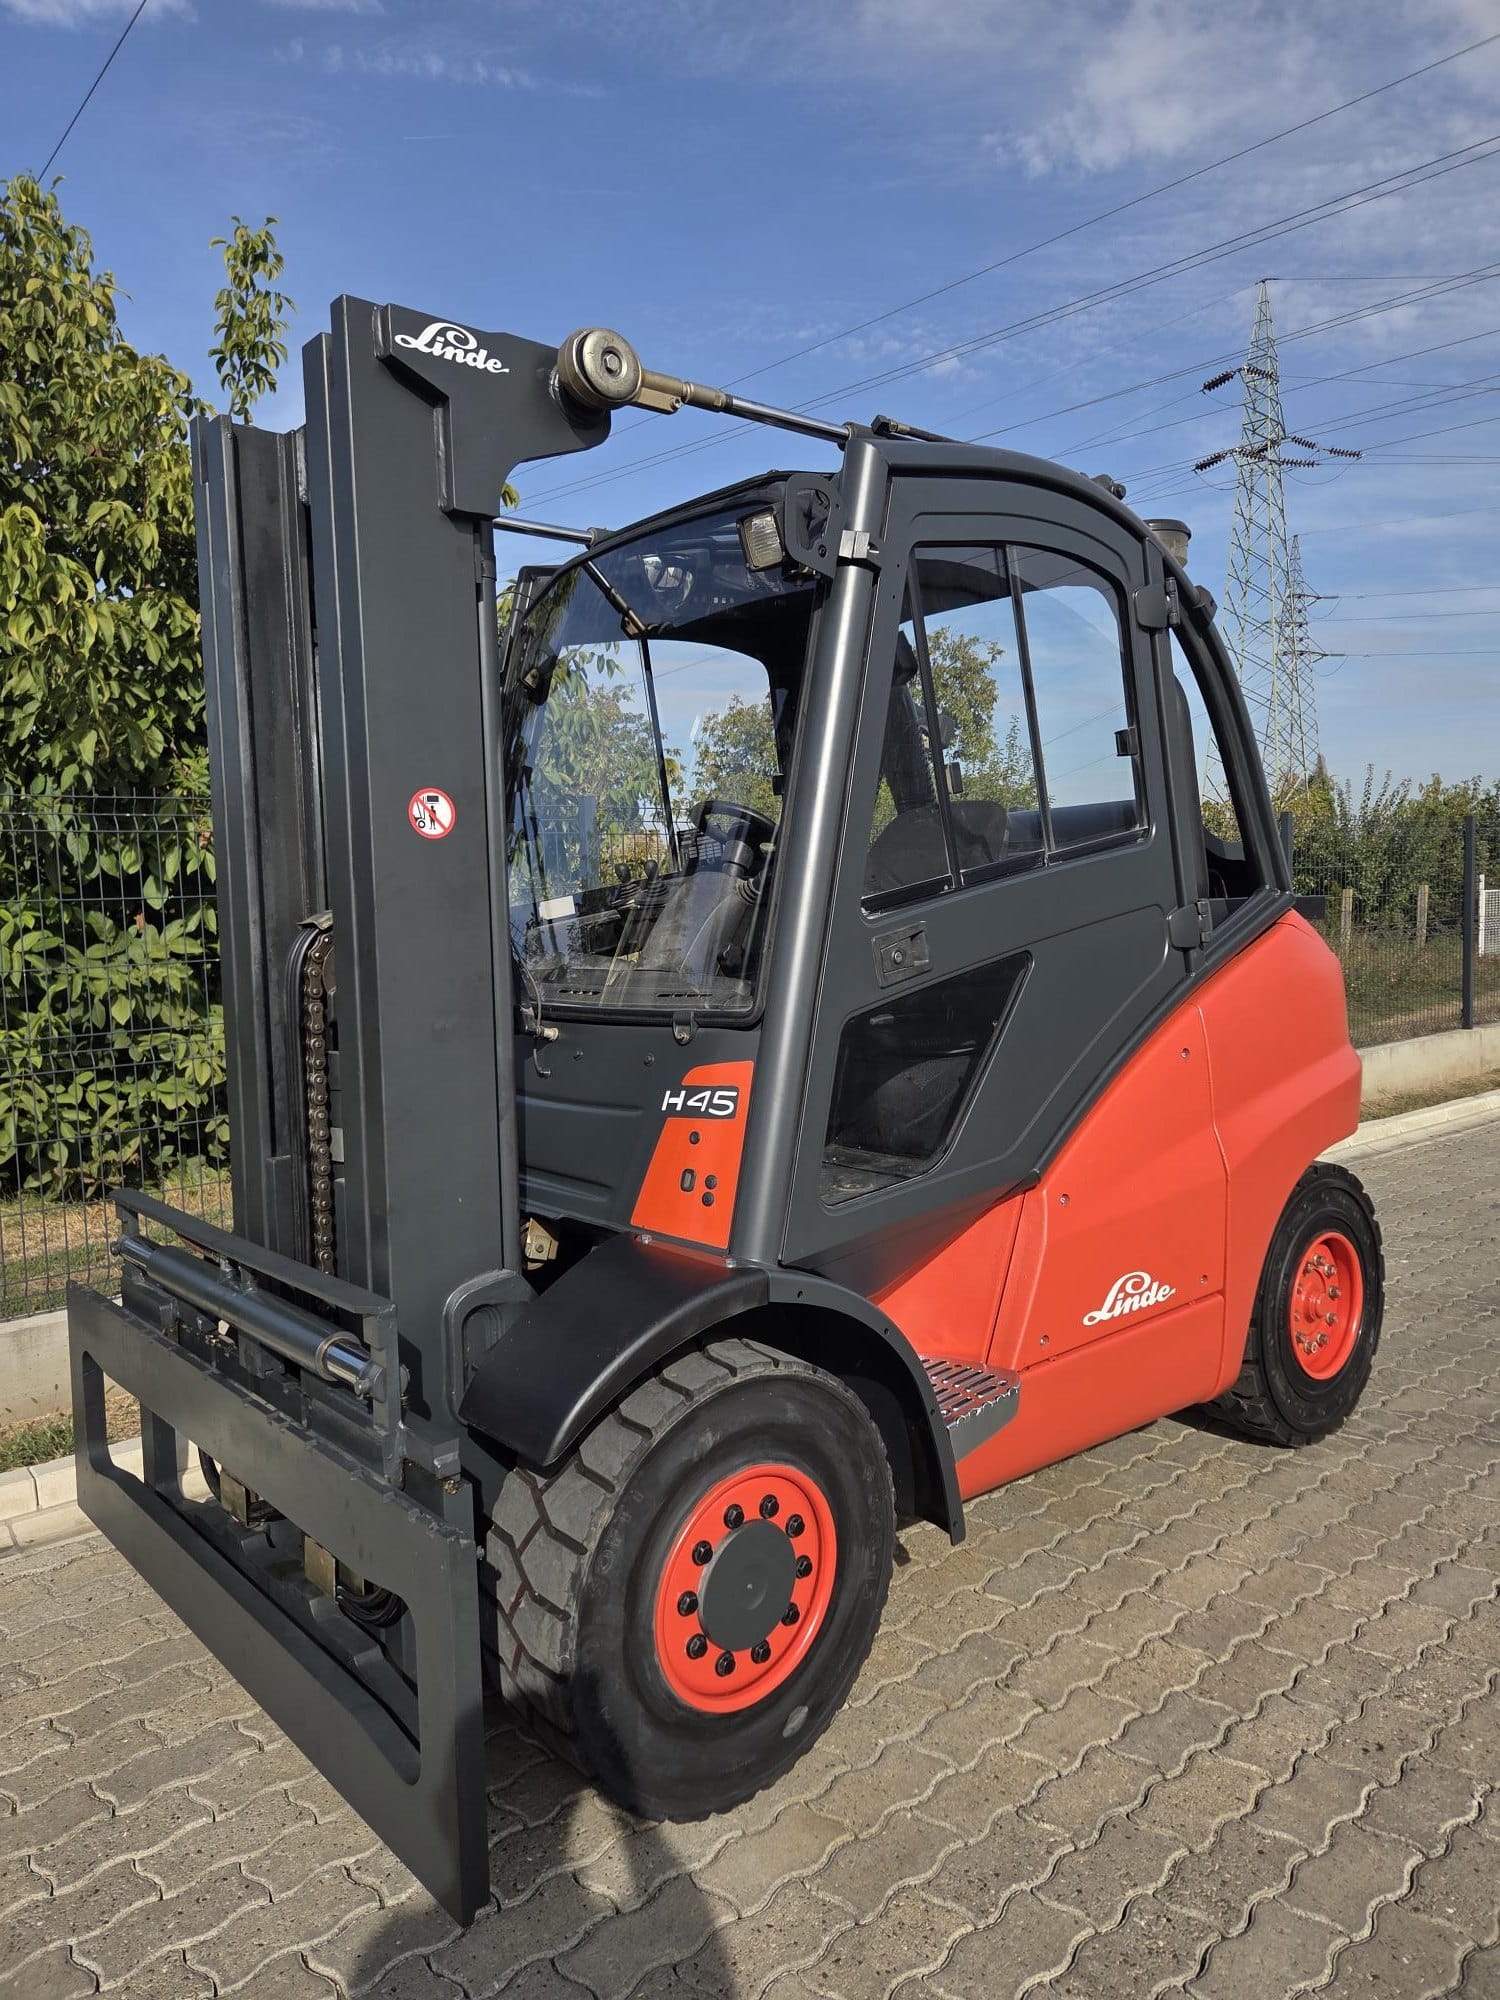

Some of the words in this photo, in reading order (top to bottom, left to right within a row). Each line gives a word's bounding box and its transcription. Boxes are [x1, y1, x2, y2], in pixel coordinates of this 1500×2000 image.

[394, 322, 510, 374] Linde
[661, 1090, 738, 1116] H45
[1082, 1271, 1177, 1326] Linde
